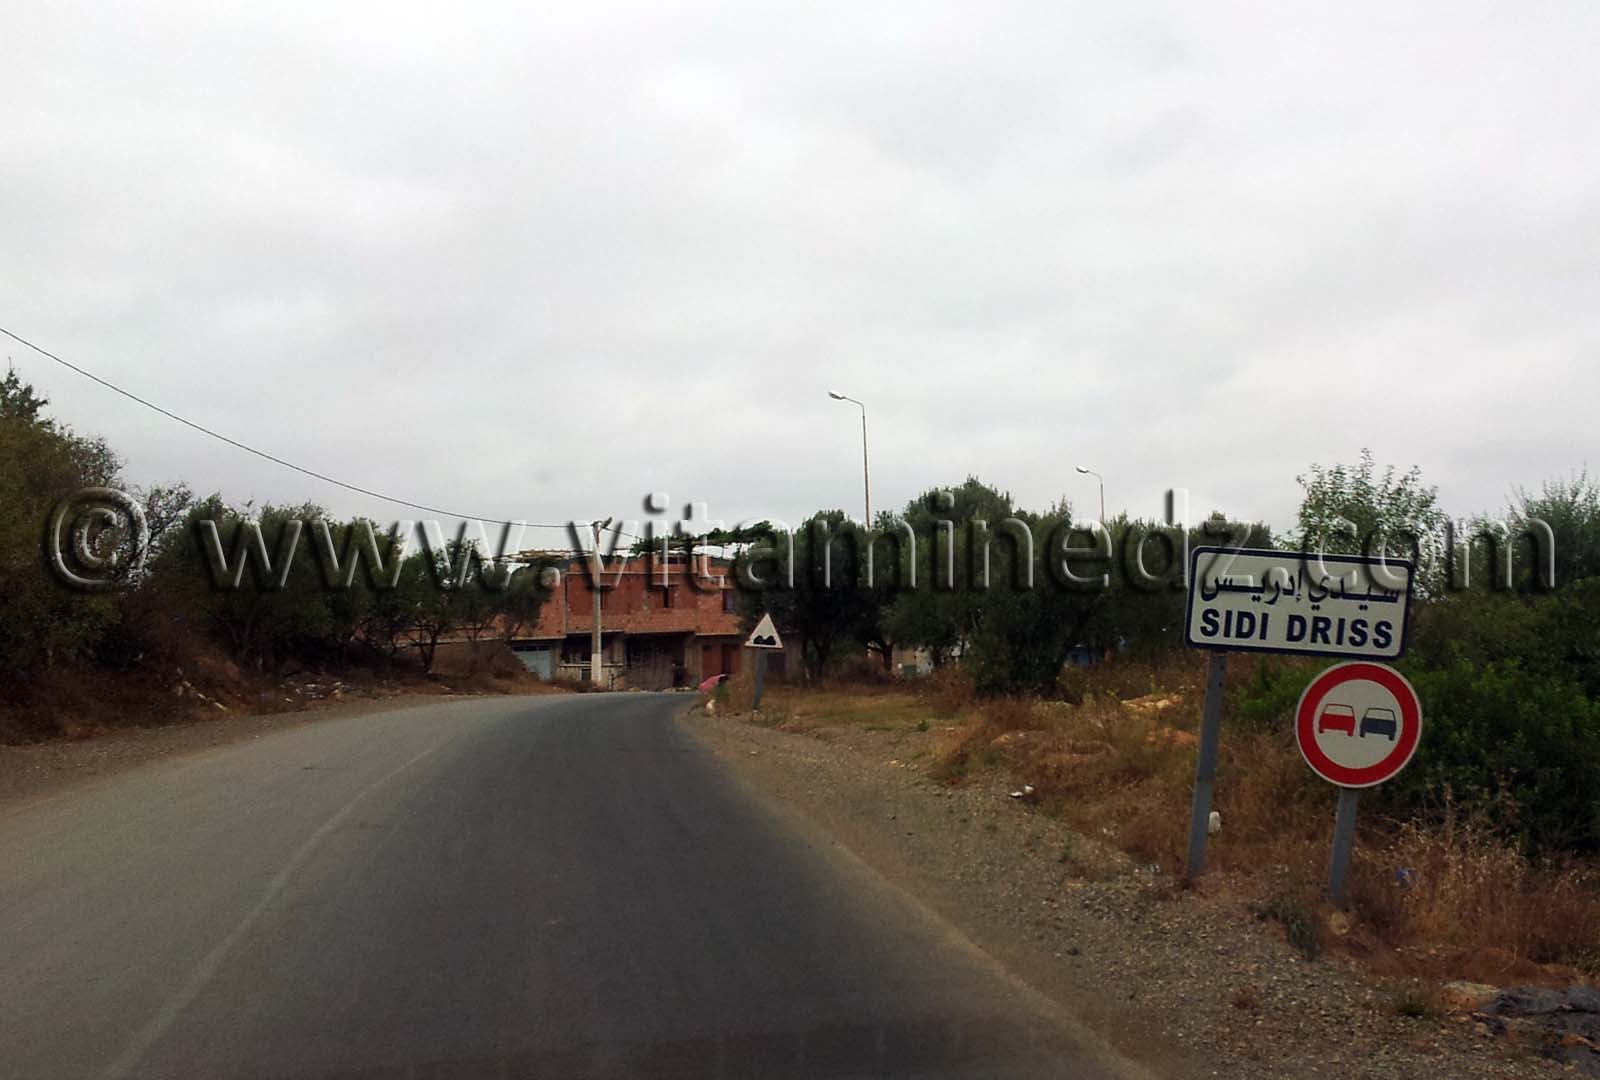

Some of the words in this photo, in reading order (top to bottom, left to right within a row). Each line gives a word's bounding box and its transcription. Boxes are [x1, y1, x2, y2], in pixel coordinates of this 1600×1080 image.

[1200, 567, 1303, 606] إدريس
[1307, 572, 1400, 611] سيدي
[1200, 608, 1269, 641] SIDI
[1286, 613, 1393, 649] DRISS
